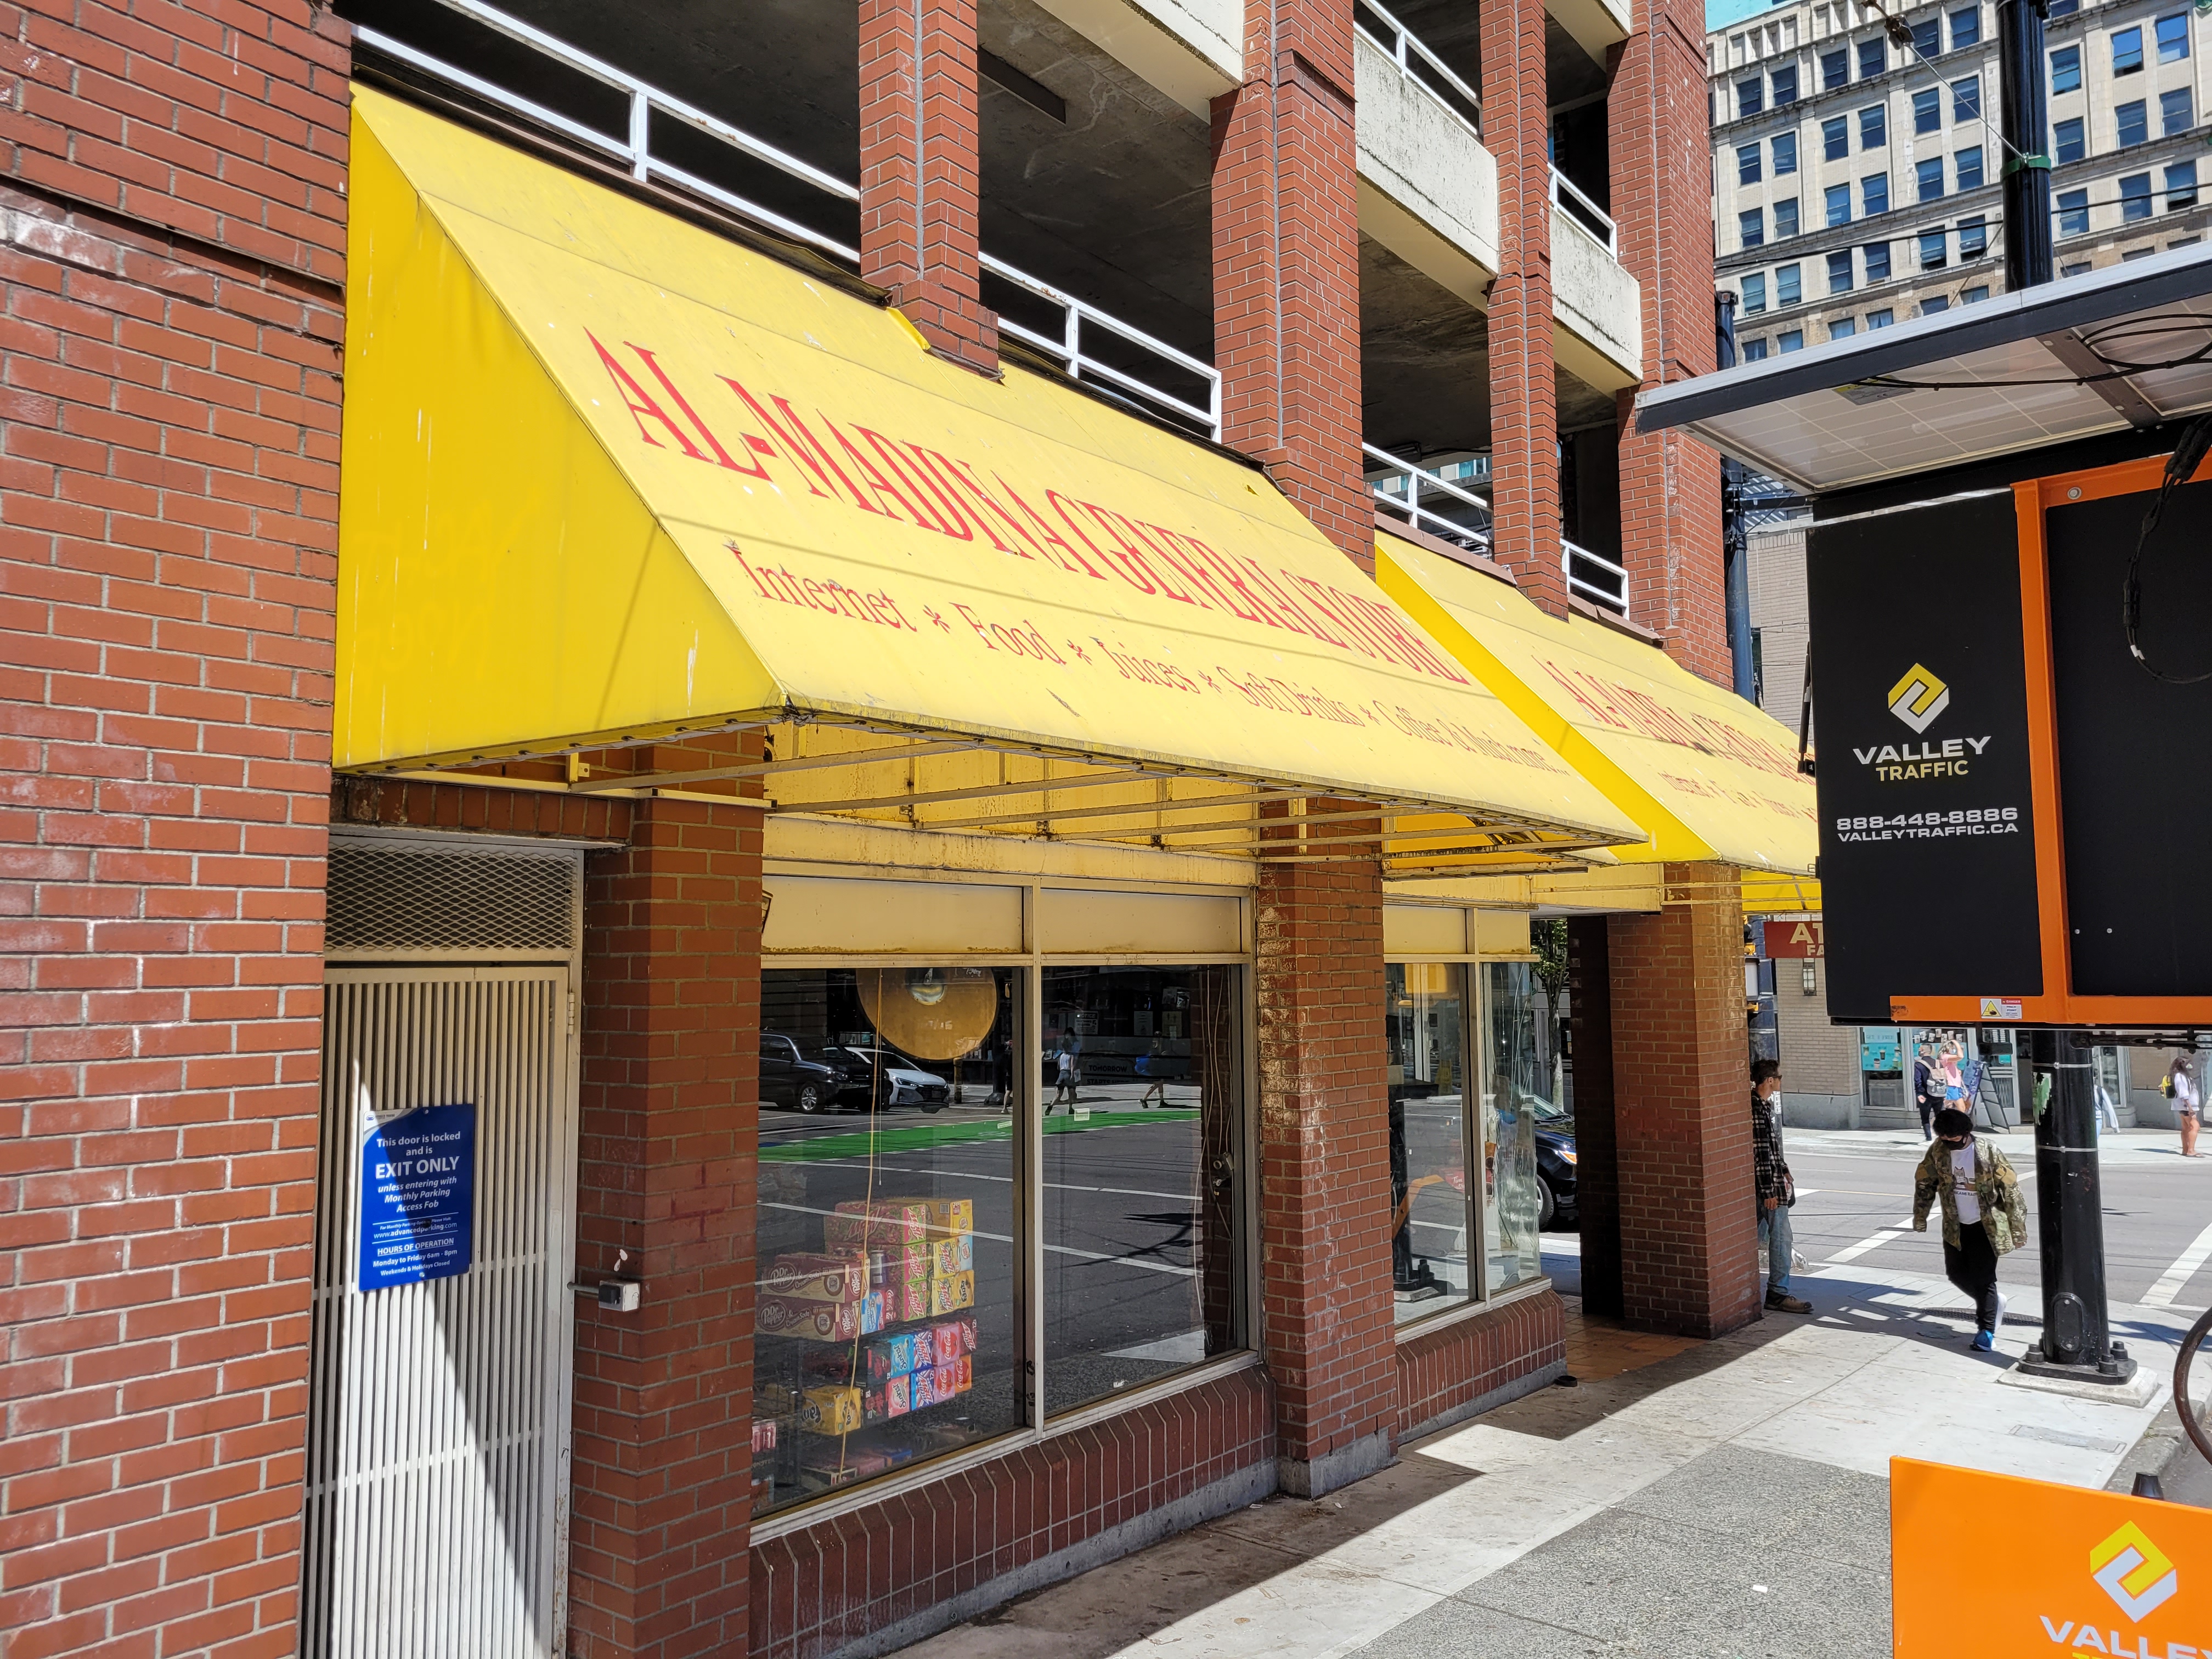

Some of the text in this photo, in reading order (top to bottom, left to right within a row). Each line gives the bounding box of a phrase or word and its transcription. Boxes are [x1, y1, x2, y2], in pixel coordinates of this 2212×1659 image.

[583, 326, 1472, 686] AL-MADINA GENERAL STORE
[723, 543, 917, 633] Internet
[949, 602, 1066, 665] Food
[1090, 636, 1201, 695] Juices
[1216, 665, 1274, 712] Soft
[1264, 676, 1365, 727] Drinks
[1372, 700, 1454, 747] Coffee
[1436, 719, 1478, 753] &
[1451, 723, 1523, 764] Much
[1853, 736, 1991, 764] VALLEY
[1876, 760, 1968, 781] TRAFFIC
[1836, 807, 2018, 831] 888-448-8886
[1838, 823, 2019, 842] VALLEYTRAFFIC.CA
[376, 1131, 461, 1148] This door is locked
[405, 1147, 424, 1156] and
[375, 1155, 460, 1179] EXIT ONLY
[377, 1176, 457, 1193] unless entering with
[384, 1188, 450, 1203] Monthly Parking
[396, 1200, 439, 1212] Access Fob
[377, 1245, 403, 1256] HOURS
[415, 1237, 454, 1249] OPERATION
[941, 1245, 954, 1272] Dew
[373, 1257, 399, 1267] Monday
[407, 1254, 426, 1262] Friday
[380, 1266, 407, 1276] Weekends
[412, 1263, 433, 1272] Holidays
[780, 1267, 788, 1277] Dr
[939, 1255, 949, 1271] Mtn
[772, 1270, 794, 1286] Pepper
[851, 1278, 856, 1288] Dr
[910, 1287, 922, 1313] Dew
[938, 1291, 947, 1308] Mtn
[941, 1282, 953, 1308] Dew
[960, 1279, 968, 1303] Fanta
[764, 1307, 784, 1325] Pepper
[770, 1305, 779, 1315] Dr
[842, 1317, 847, 1326] Dr
[893, 1345, 907, 1370] Sunkist
[918, 1336, 931, 1364] Dew
[887, 1372, 891, 1380] 12
[892, 1383, 907, 1408] Sunkist
[919, 1375, 932, 1403] Dew
[2039, 1615, 2212, 1659] VALLE
